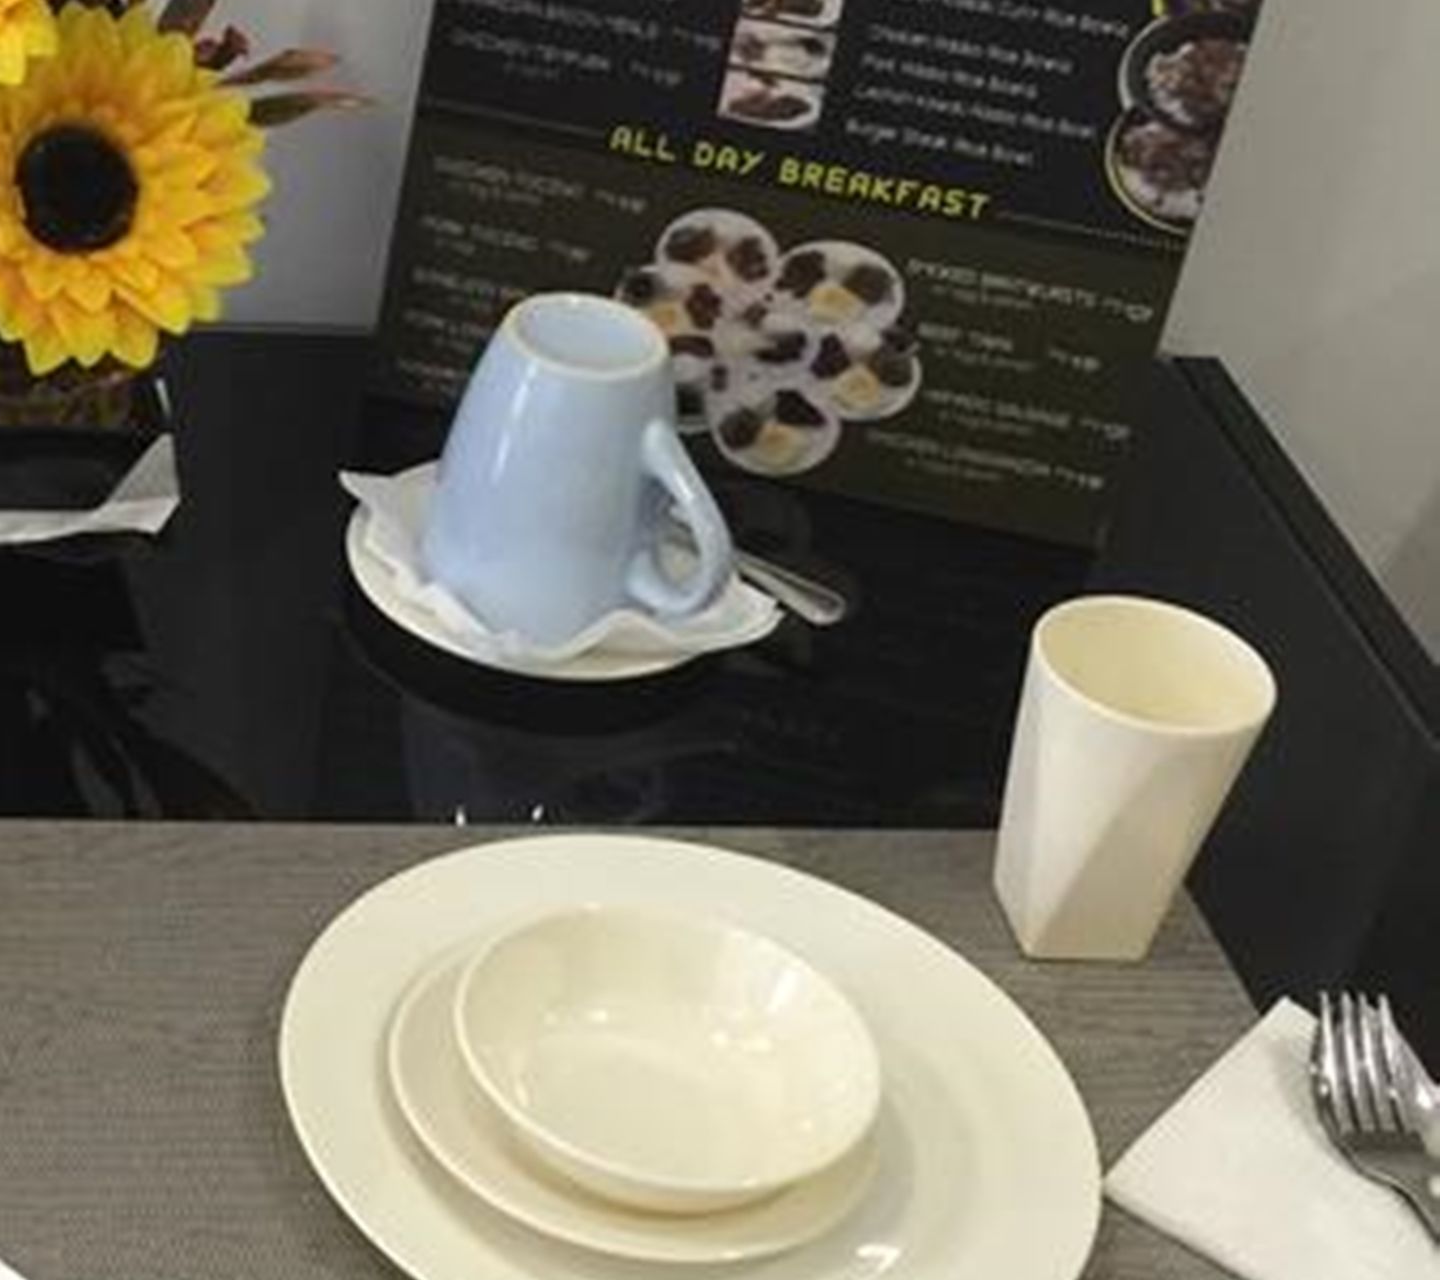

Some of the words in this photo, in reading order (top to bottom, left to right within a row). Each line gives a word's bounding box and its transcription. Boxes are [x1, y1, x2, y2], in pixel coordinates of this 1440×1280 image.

[610, 126, 675, 162] ALL
[693, 141, 763, 174] DAY
[779, 157, 990, 218] BREAKFAST
